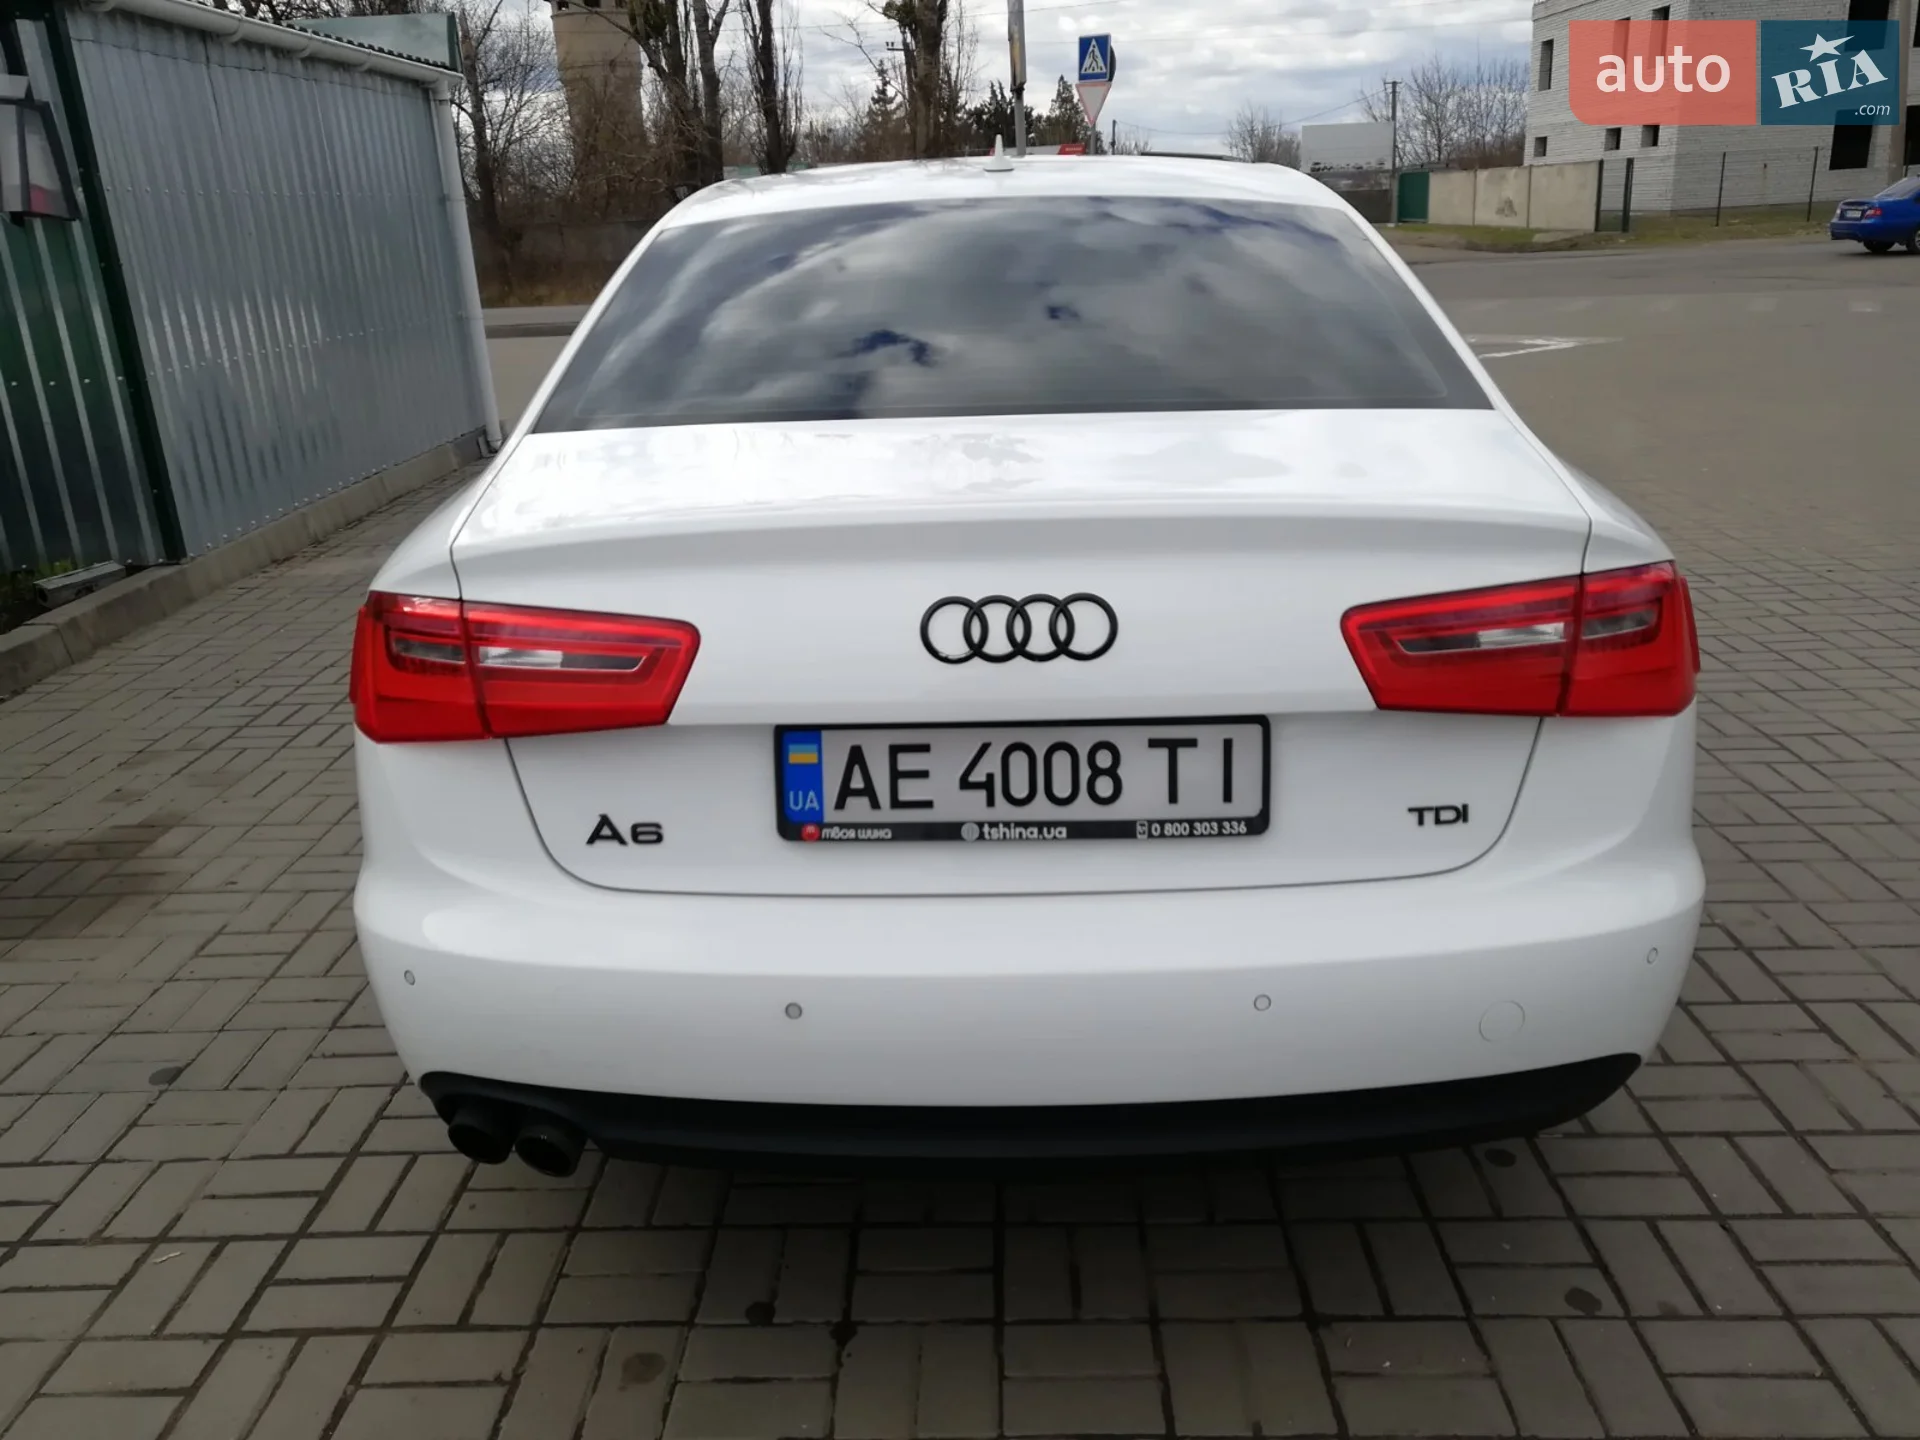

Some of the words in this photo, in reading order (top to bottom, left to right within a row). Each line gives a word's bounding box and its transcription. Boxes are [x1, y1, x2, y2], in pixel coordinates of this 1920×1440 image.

[833, 743, 934, 811] AE
[958, 740, 1123, 807] 4008
[788, 791, 821, 812] UA
[1407, 803, 1469, 826] TDI
[586, 813, 663, 846] A6
[982, 822, 1068, 840] tshina.ua
[1151, 824, 1160, 836] 0
[1164, 823, 1190, 836] 800
[1193, 822, 1219, 835] 303
[1222, 821, 1248, 835] 336
